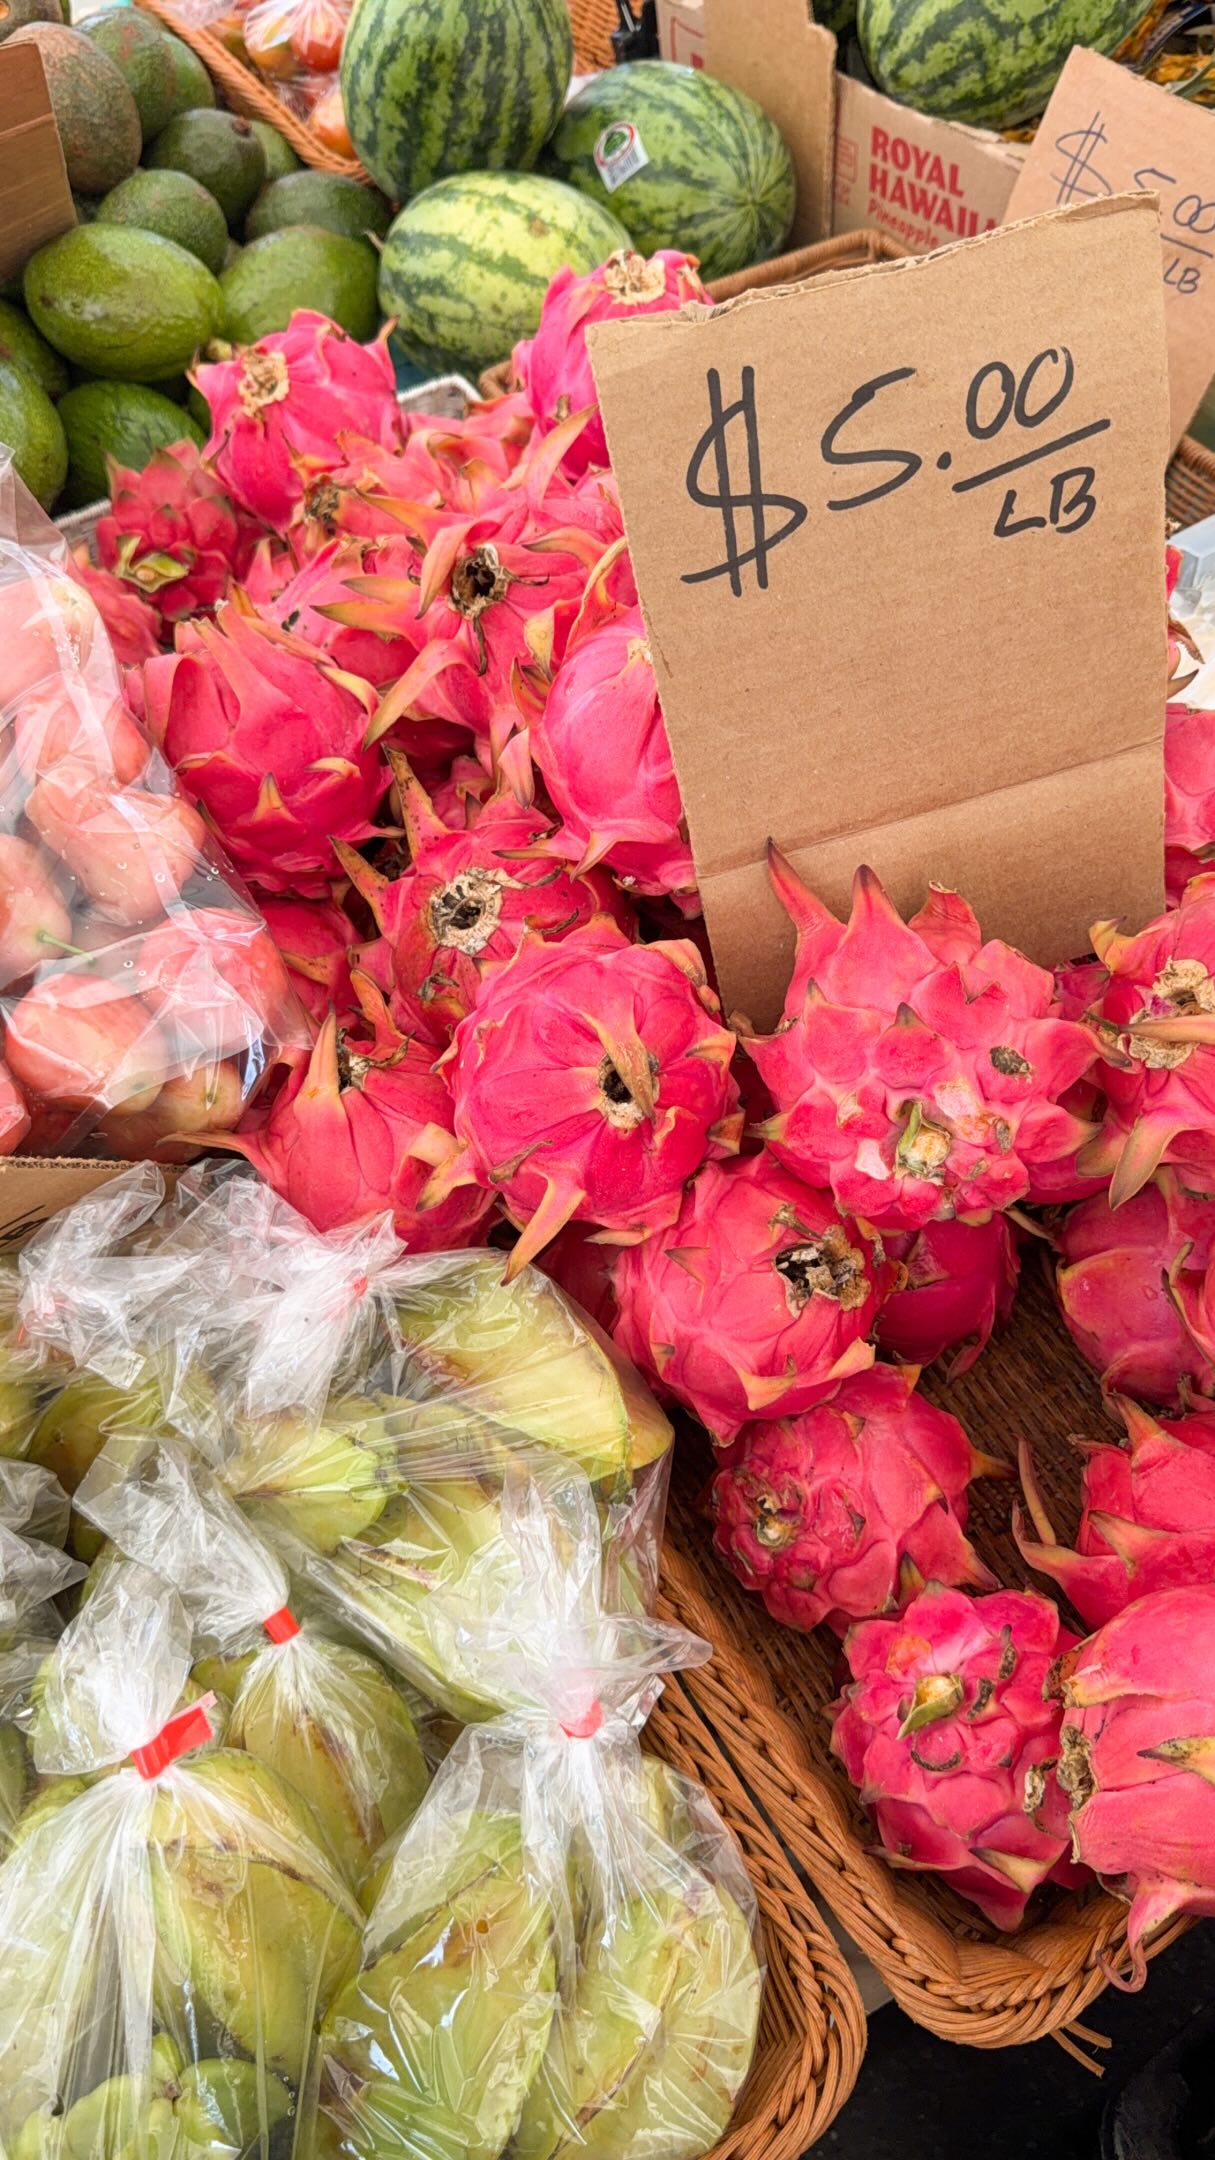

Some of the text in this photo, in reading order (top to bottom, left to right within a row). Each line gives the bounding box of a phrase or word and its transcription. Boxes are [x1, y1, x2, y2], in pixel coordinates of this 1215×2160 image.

[871, 126, 965, 198] ROYAL
[868, 198, 940, 250] Pineapple
[1163, 258, 1201, 293] LB
[993, 466, 1097, 538] LB
